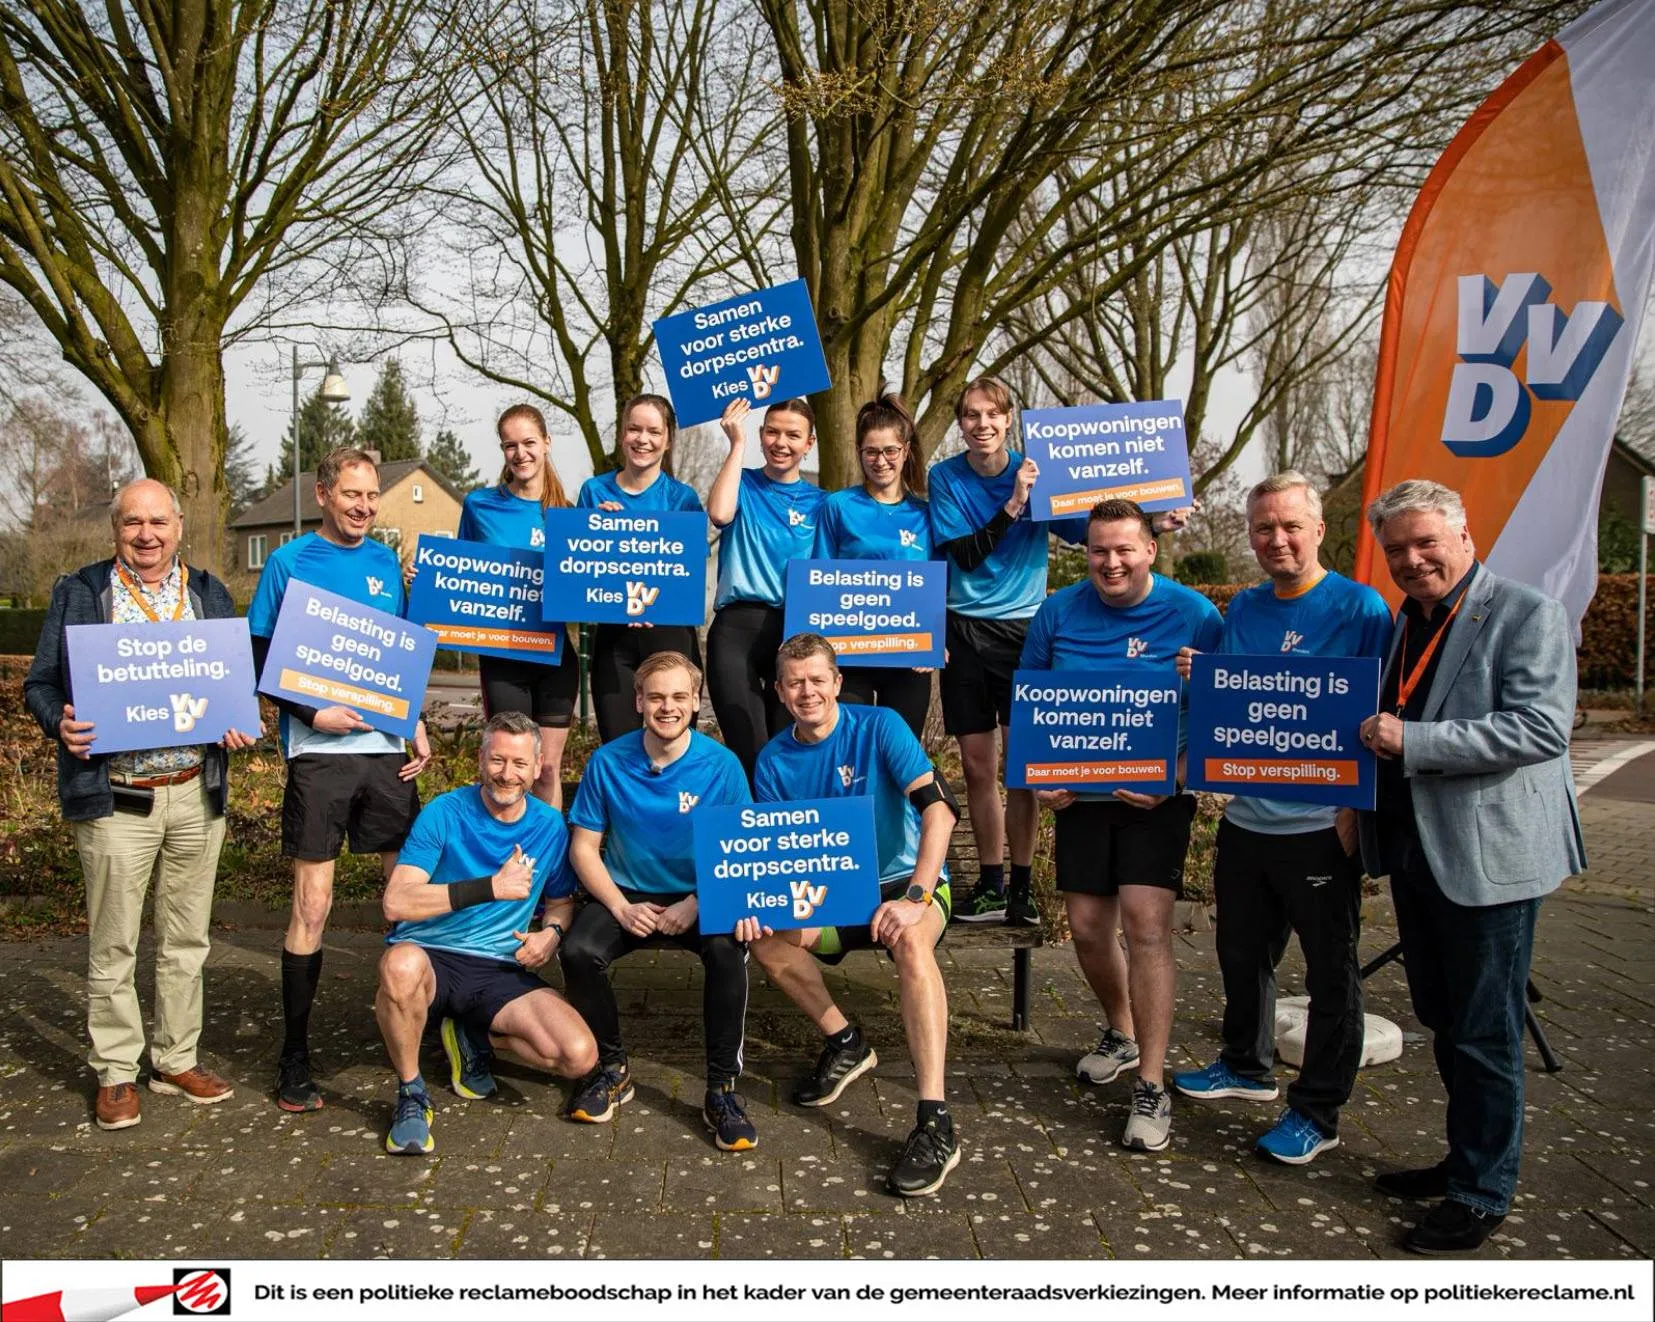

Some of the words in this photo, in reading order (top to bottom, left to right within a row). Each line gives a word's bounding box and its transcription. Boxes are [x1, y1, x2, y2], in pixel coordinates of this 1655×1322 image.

[694, 301, 763, 330] Samen
[680, 332, 724, 357] voor
[729, 315, 792, 343] sterke
[680, 335, 805, 379] dorpscentra.
[1440, 272, 1625, 458] VVD
[712, 380, 749, 399] Kies
[746, 364, 781, 400] VVD
[1025, 415, 1182, 440] Koopwoningen
[1048, 441, 1119, 460] komen
[1125, 435, 1165, 454] niet
[1069, 458, 1149, 480] vanzelf.
[1051, 498, 1075, 508] Daar
[1116, 488, 1139, 499] voor
[588, 514, 659, 532] Samen
[568, 539, 613, 553] voor
[619, 537, 684, 554] sterke
[418, 547, 544, 585] Koopwoning
[560, 557, 690, 578] dorpscentra.
[435, 572, 504, 597] komen
[809, 570, 901, 590] Belasting
[907, 571, 924, 587] is
[587, 588, 624, 603] Kies
[626, 581, 660, 616] VVD
[840, 593, 891, 609] geen
[450, 600, 526, 622] vanzelf.
[809, 611, 921, 630] speelgoed.
[306, 597, 396, 647] Belasting
[400, 632, 416, 651] is
[117, 638, 172, 659] Stop
[178, 636, 207, 653] de
[331, 633, 381, 662] geen
[450, 630, 476, 640] moet
[477, 630, 487, 641] je
[489, 632, 510, 642] voor
[511, 633, 553, 645] bouwen.
[850, 637, 918, 650] verspilling.
[97, 659, 230, 683] betutteling.
[296, 645, 402, 692] speelgoed.
[297, 676, 328, 694] Stop
[1214, 668, 1321, 699] Belasting
[1328, 672, 1349, 694] is
[1015, 684, 1177, 708] Koopwoningen
[126, 705, 169, 722] Kies
[169, 692, 209, 733] VVD
[1033, 707, 1105, 726] komen
[1111, 708, 1154, 728] niet
[1248, 701, 1307, 723] geen
[1050, 732, 1132, 751] vanzelf.
[1214, 726, 1343, 752] speelgoed.
[1026, 767, 1051, 777] Daar
[1052, 766, 1079, 776] moet
[1080, 765, 1090, 777] je
[1092, 766, 1116, 775] voor
[1118, 764, 1164, 775] bouwen.
[1223, 762, 1256, 778] Stop
[1260, 763, 1340, 782] verspilling.
[740, 809, 820, 828] Samen
[720, 836, 771, 854] voor
[777, 829, 849, 850] sterke
[714, 854, 860, 881] dorpscentra.
[746, 891, 788, 909] Kies
[789, 880, 827, 920] VVD
